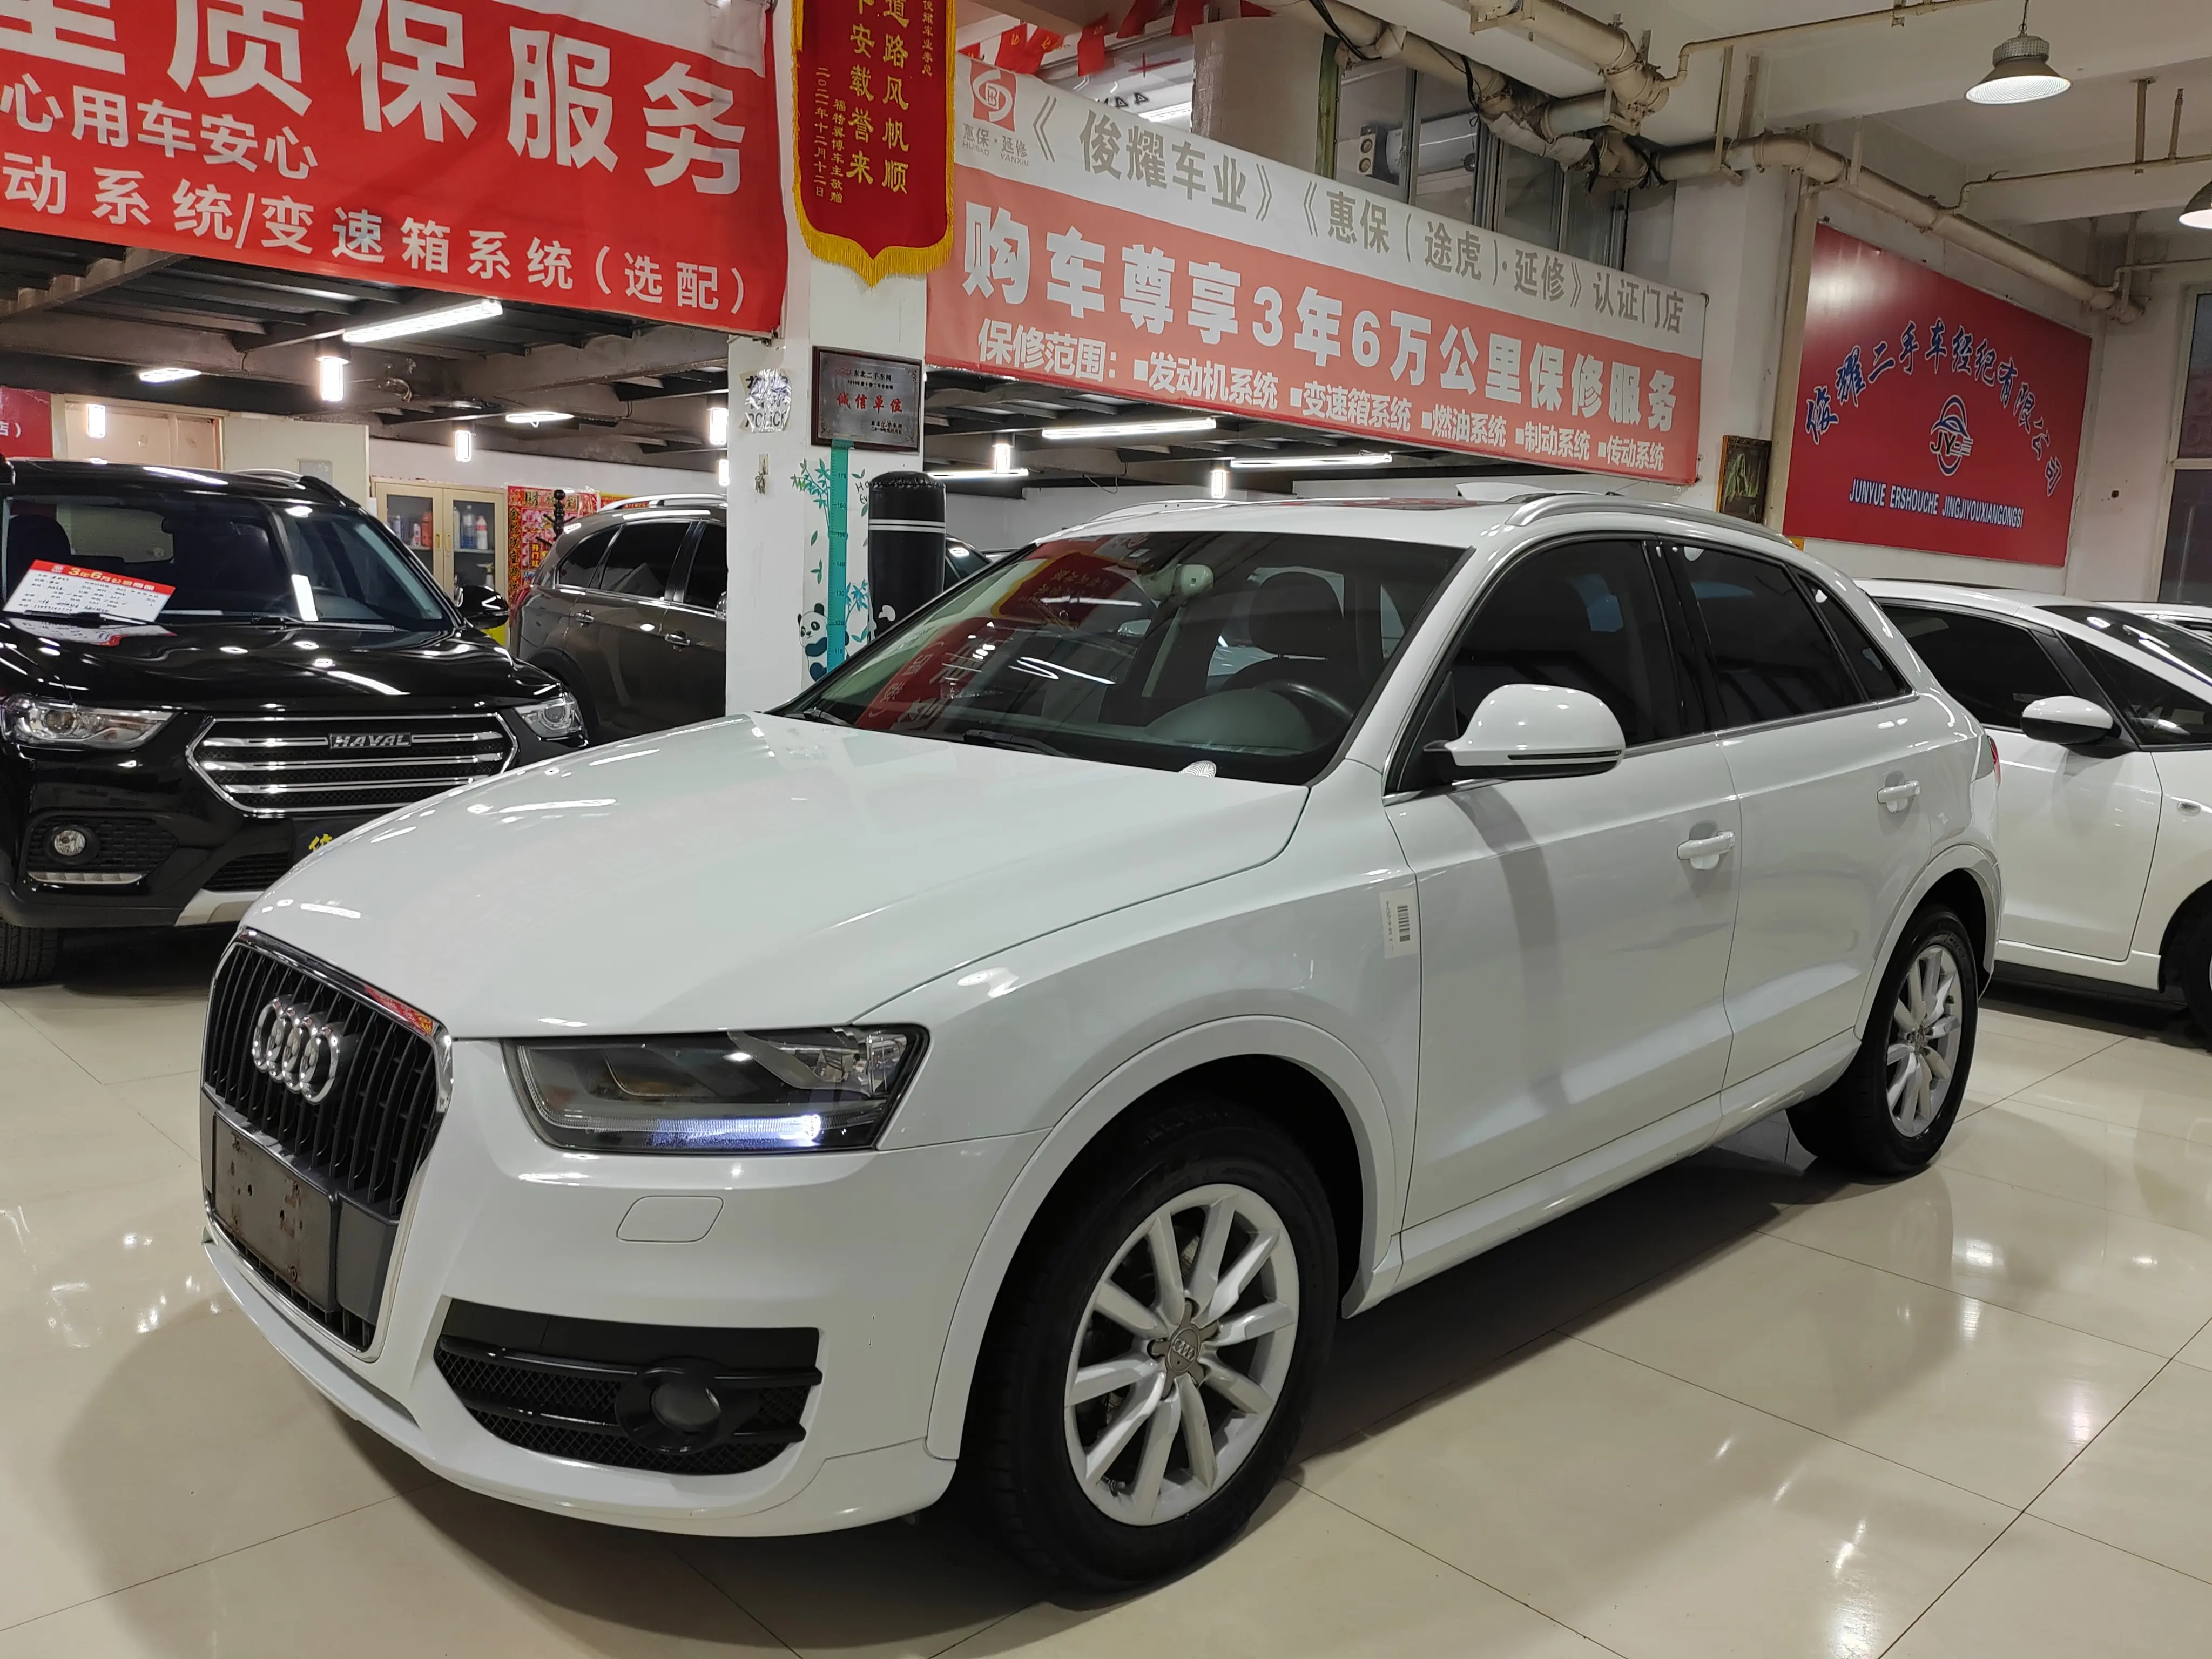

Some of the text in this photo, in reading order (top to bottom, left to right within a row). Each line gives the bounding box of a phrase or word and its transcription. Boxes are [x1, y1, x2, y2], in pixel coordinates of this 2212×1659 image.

[1000, 152, 1029, 166] YANXIU
[962, 201, 1676, 431] 购车尊享3年6万公里保修服务
[1149, 351, 1279, 410] 发动机系统
[1302, 380, 1412, 432] 变速箱系统
[1431, 403, 1507, 447] 燃油系统
[1525, 421, 1591, 460] 制动系统
[1606, 435, 1664, 471] 传动系统
[1849, 478, 1886, 507] JUNYUE
[1890, 485, 1939, 515] ERSHOUCHE
[333, 735, 409, 747] HAVAL
